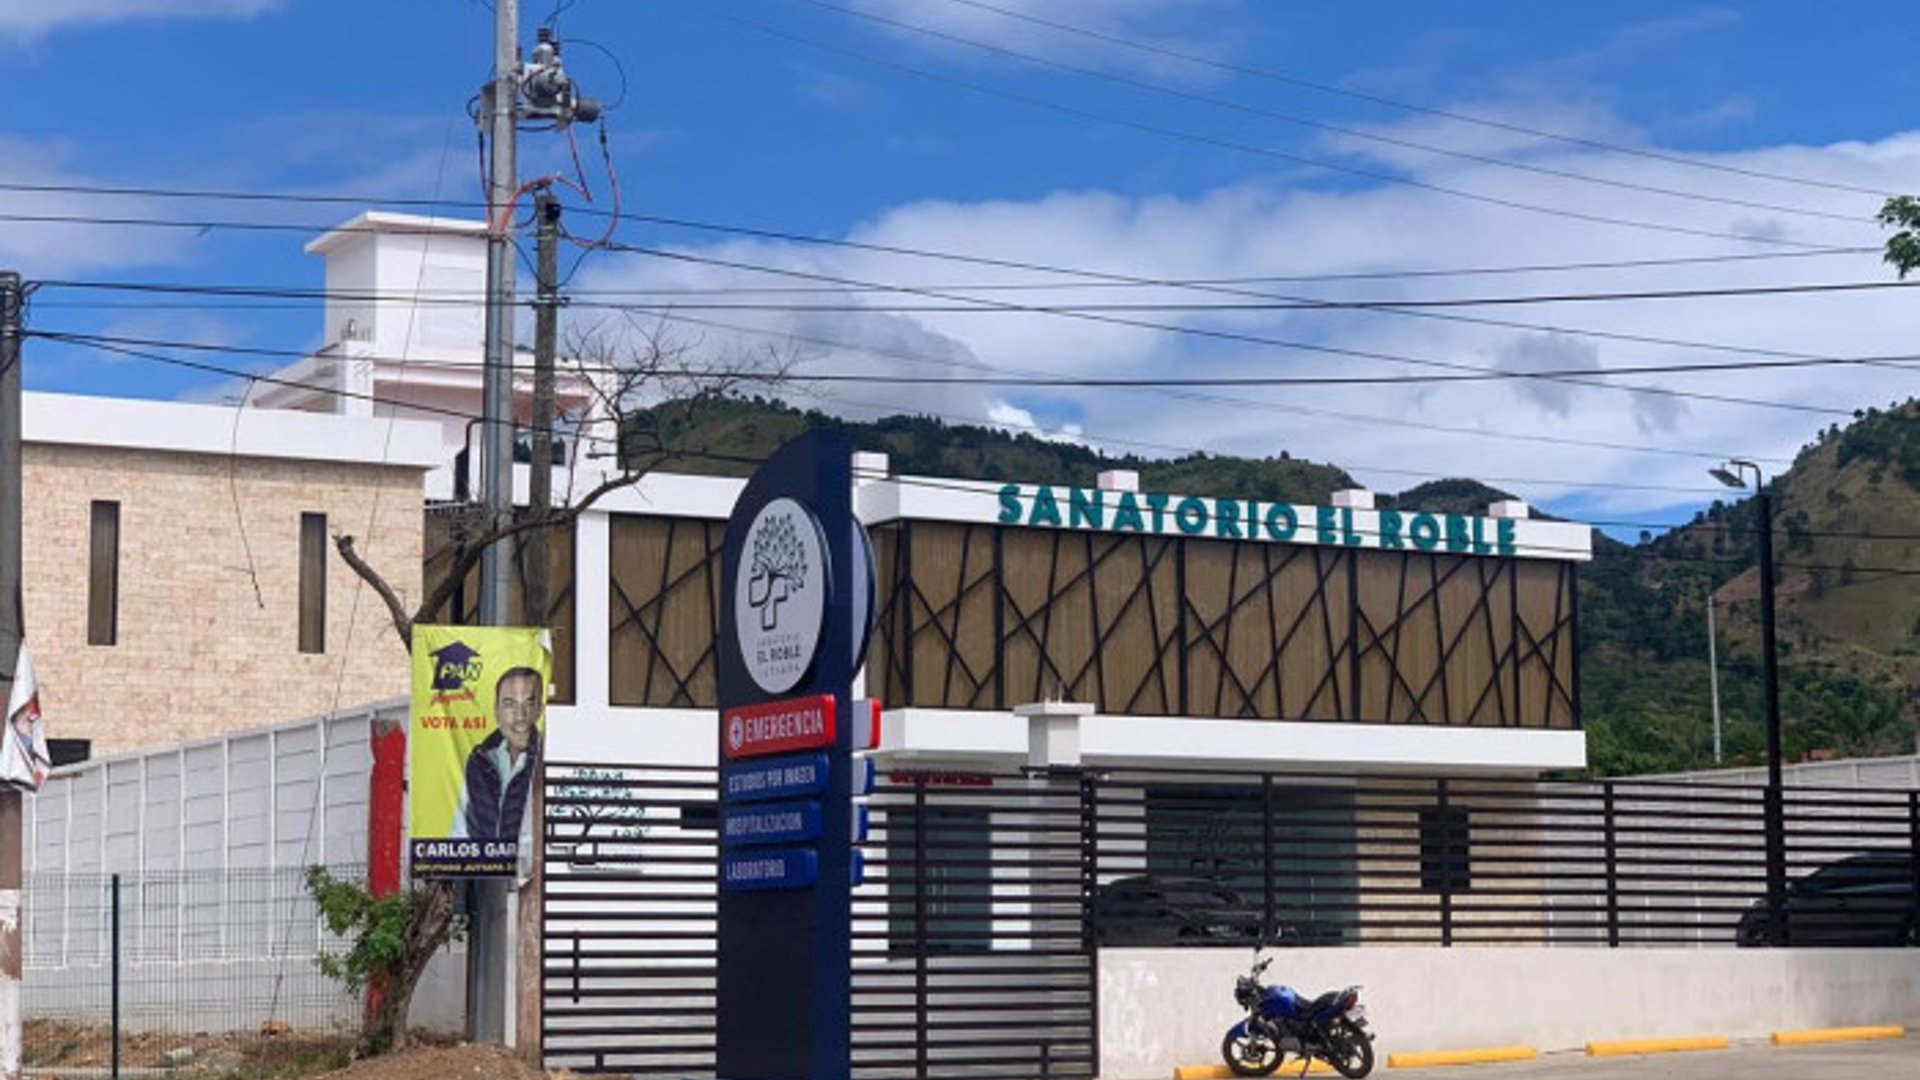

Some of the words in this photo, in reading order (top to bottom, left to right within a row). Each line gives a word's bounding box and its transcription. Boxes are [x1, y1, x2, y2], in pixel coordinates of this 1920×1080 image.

[998, 484, 1298, 541] SANATORIO
[1316, 505, 1361, 546] EL
[1379, 509, 1517, 555] ROBLE
[420, 716, 458, 729] VOTA
[745, 709, 824, 742] EMERGENCIA
[729, 771, 766, 793] ESTUDIOS
[767, 768, 782, 787] POR
[783, 766, 816, 786] IMAGEN
[415, 843, 480, 858] CARLOS
[726, 859, 785, 880] LABORATORIO
